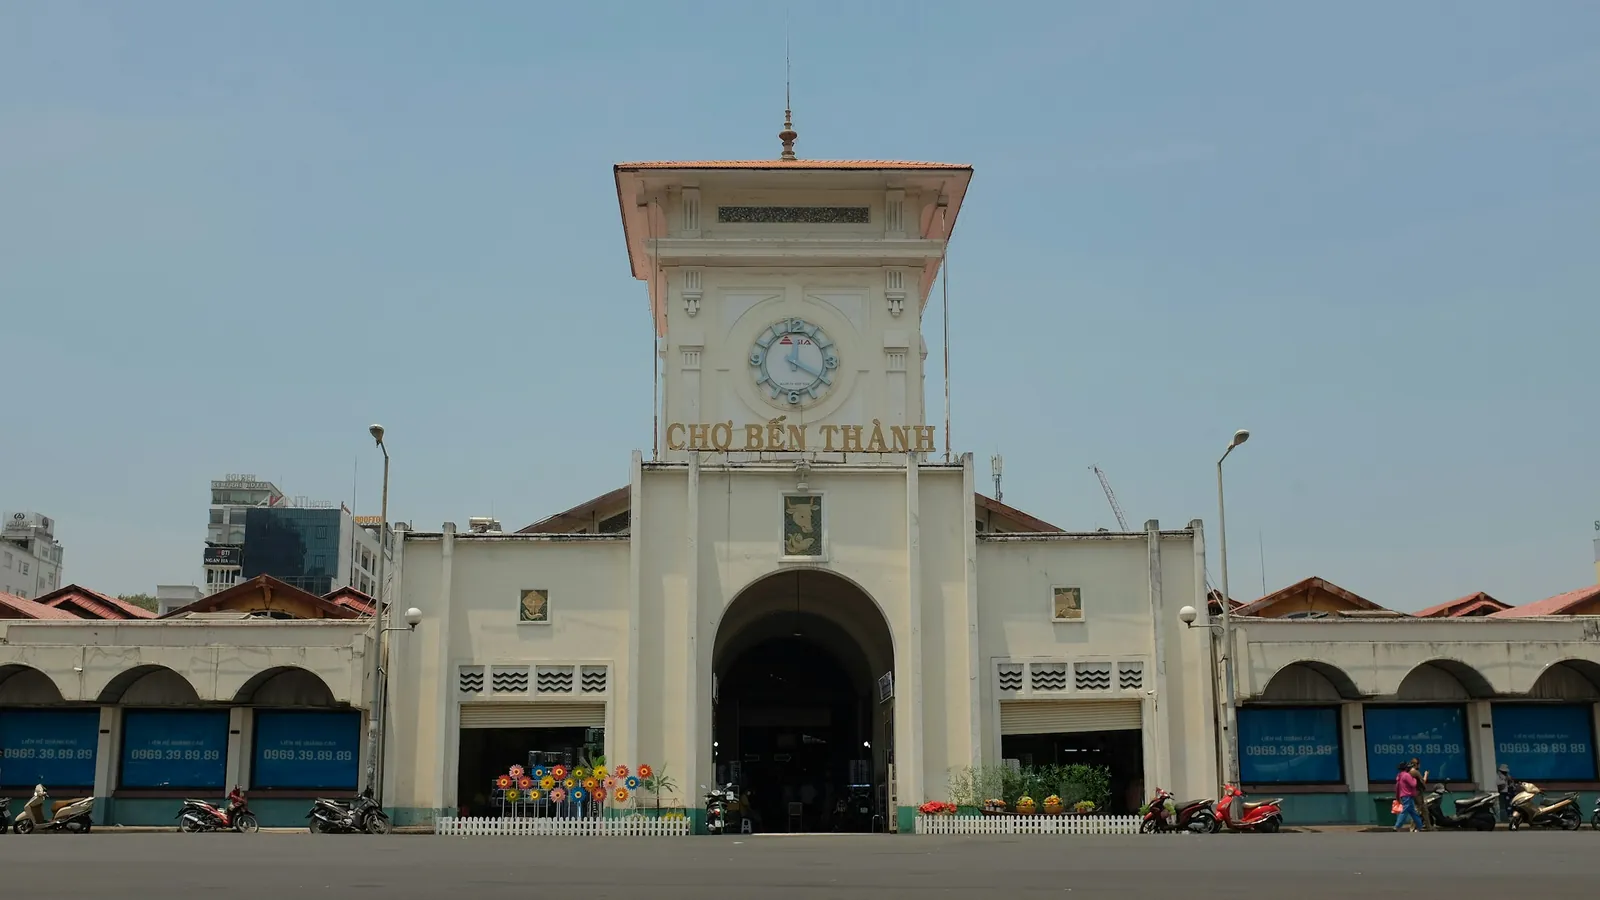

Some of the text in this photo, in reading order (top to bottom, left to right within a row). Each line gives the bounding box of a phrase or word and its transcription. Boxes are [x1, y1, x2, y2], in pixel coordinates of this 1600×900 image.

[784, 318, 805, 333] 12
[750, 353, 763, 366] 9
[825, 356, 838, 369] 3
[787, 390, 800, 404] 6
[666, 416, 936, 454] CHỢ BẾN THÀNH
[225, 473, 256, 482] GOLDEN
[1246, 744, 1332, 756] 0969.39.89.89
[1374, 743, 1460, 754] 0969.39.89.89
[1499, 742, 1586, 753] 0969.39.89.89
[4, 748, 93, 759] 0969.39.89.89
[131, 749, 219, 760] 0969.39.89.89
[263, 749, 352, 760] 0969.39.89.89
